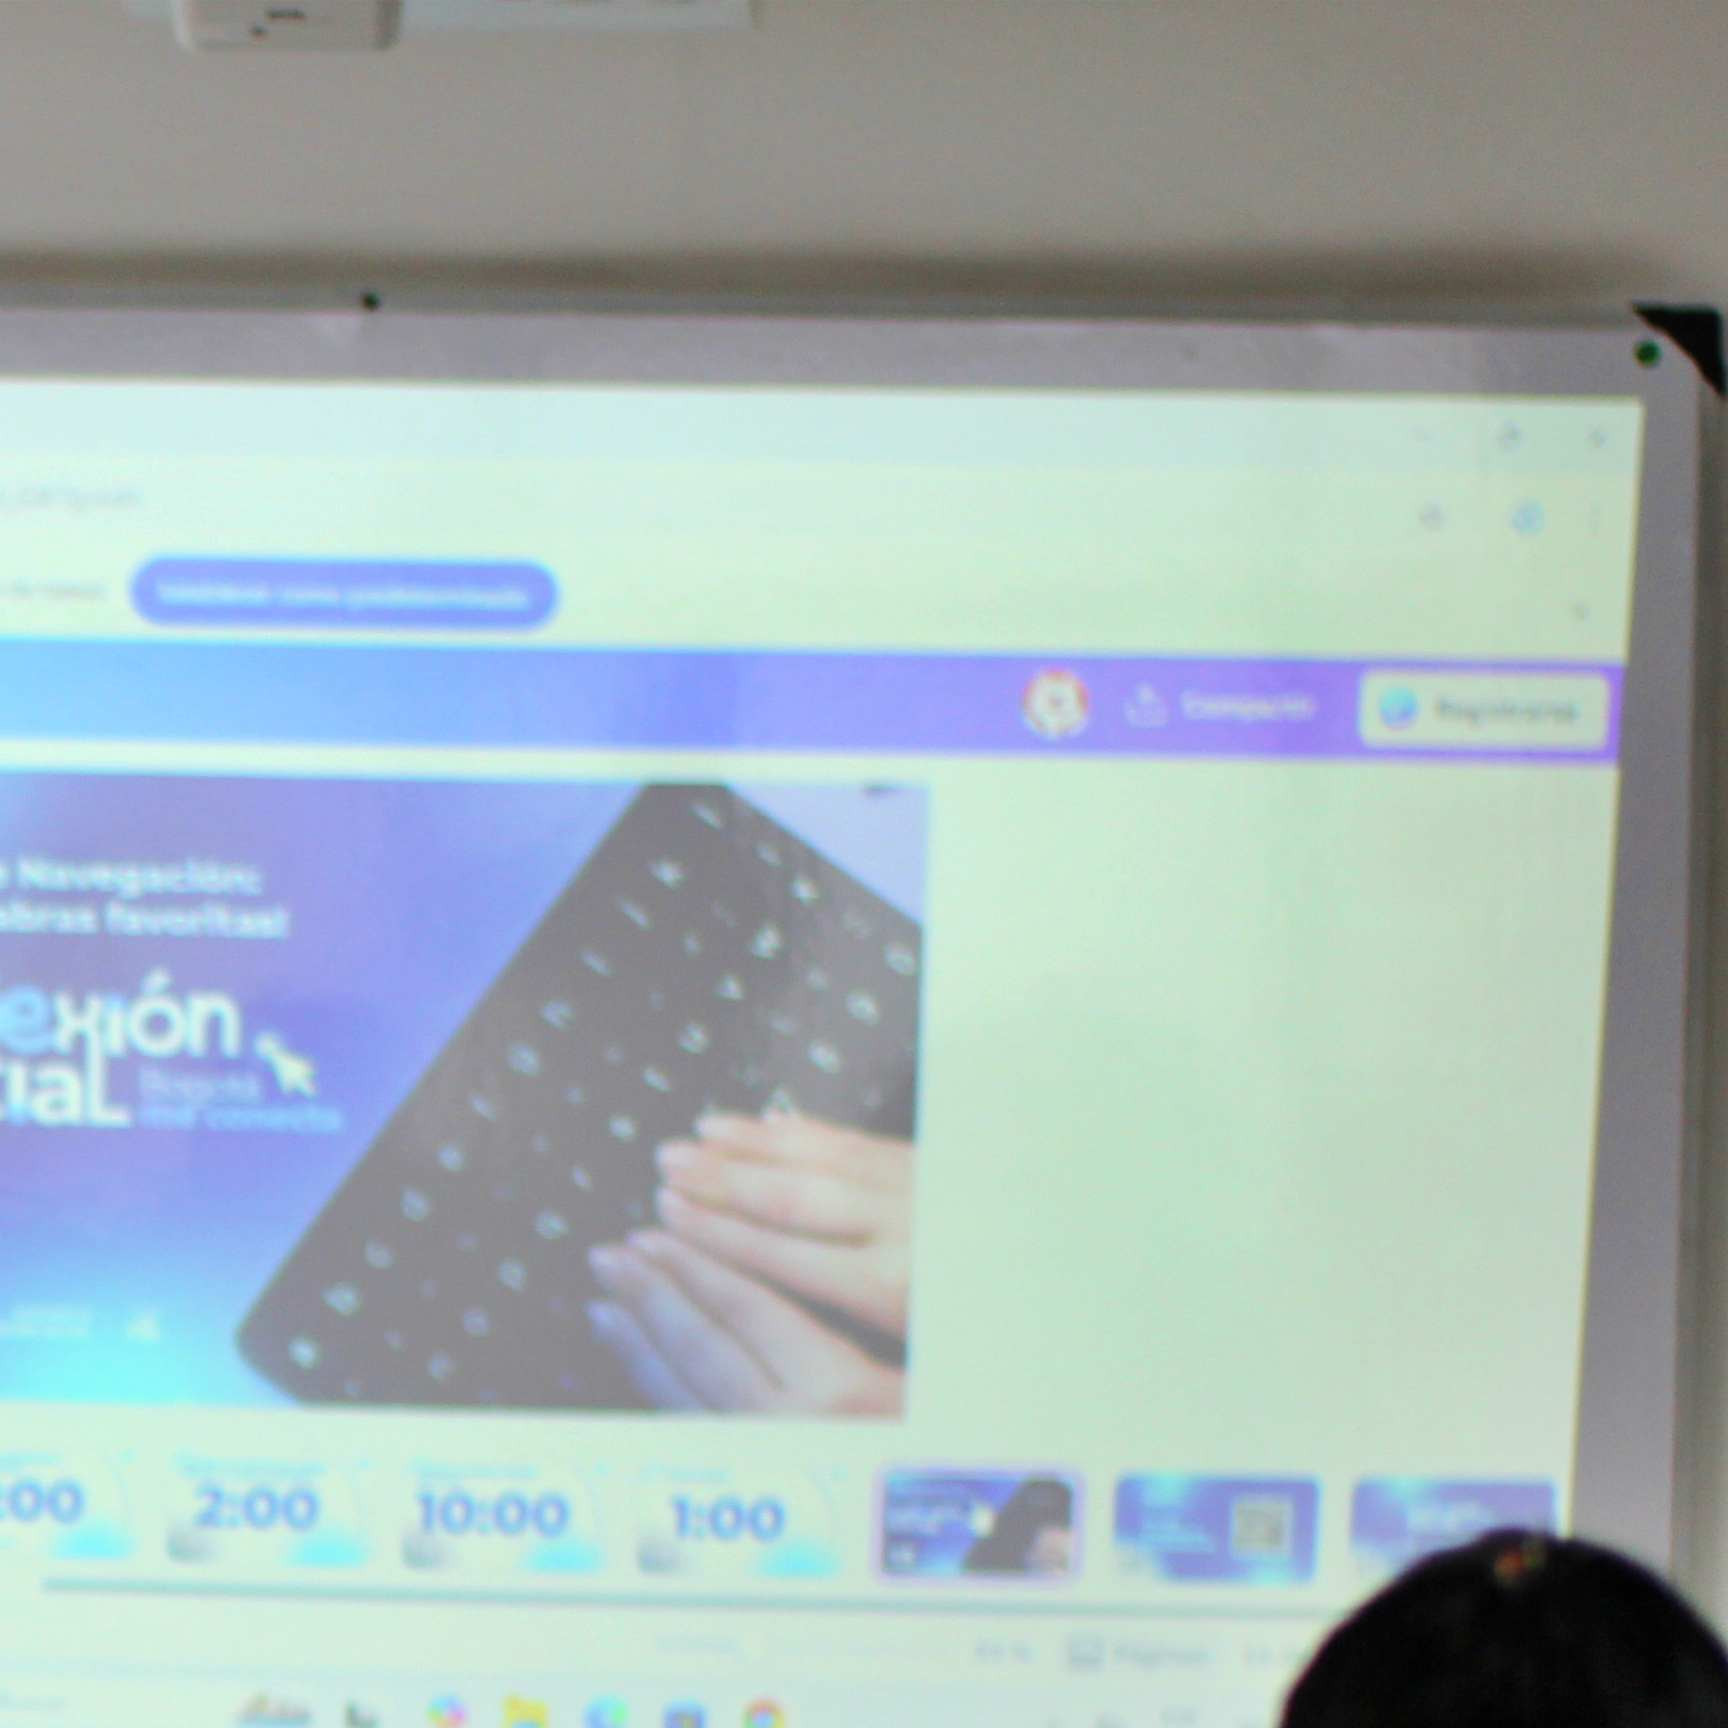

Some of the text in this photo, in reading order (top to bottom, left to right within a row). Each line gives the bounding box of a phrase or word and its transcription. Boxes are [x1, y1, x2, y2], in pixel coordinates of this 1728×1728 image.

[194, 1481, 320, 1531] 2:00
[416, 1489, 570, 1537] 10:00
[670, 1495, 786, 1541] 1:00
